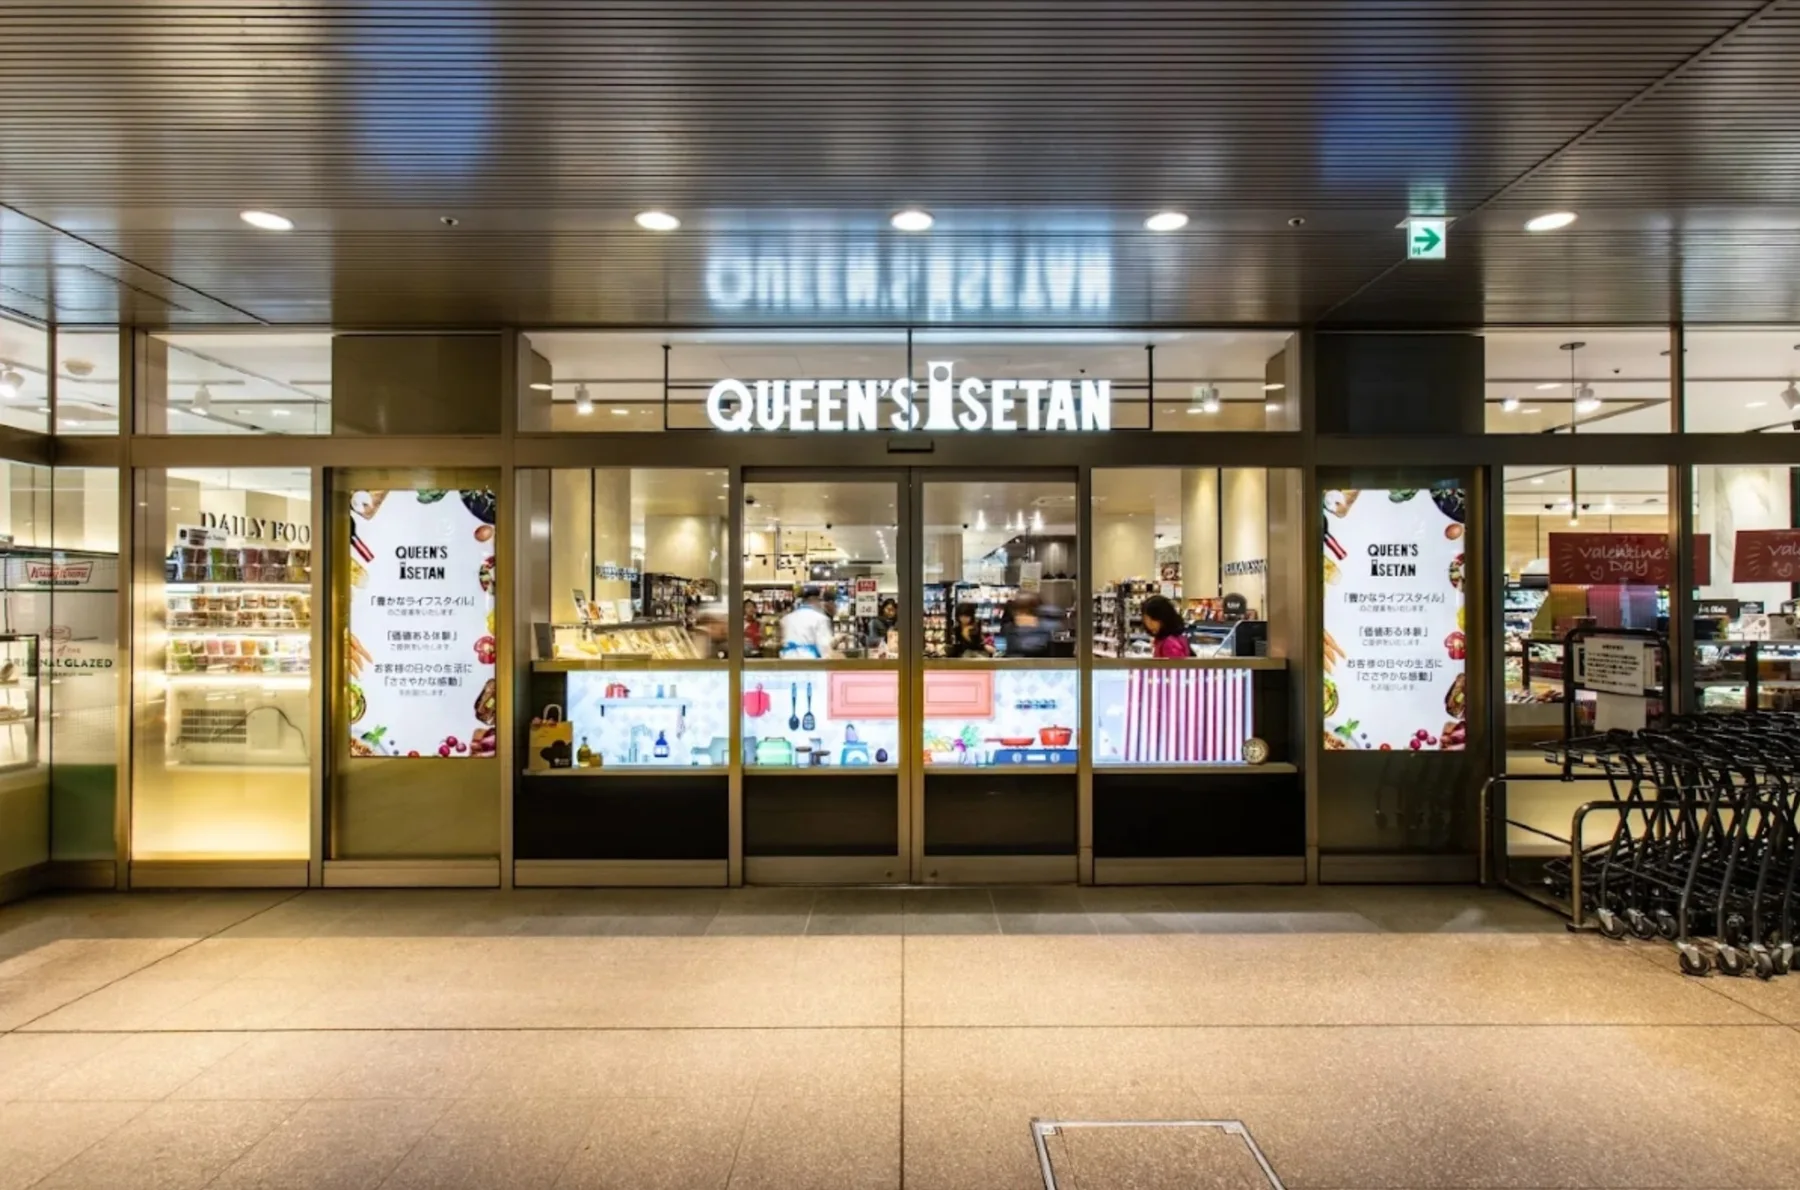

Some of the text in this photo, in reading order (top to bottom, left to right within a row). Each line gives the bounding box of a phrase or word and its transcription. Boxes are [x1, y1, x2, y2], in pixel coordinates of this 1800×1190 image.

[706, 361, 1112, 433] QUEEN'S ISETAN
[199, 511, 266, 539] DAILY
[395, 545, 448, 559] QUEEN'S
[1367, 543, 1419, 557] QUEEN'S
[399, 562, 445, 579] ISETAN
[1370, 559, 1416, 577] ISETAN
[64, 658, 113, 668] GLAZED
